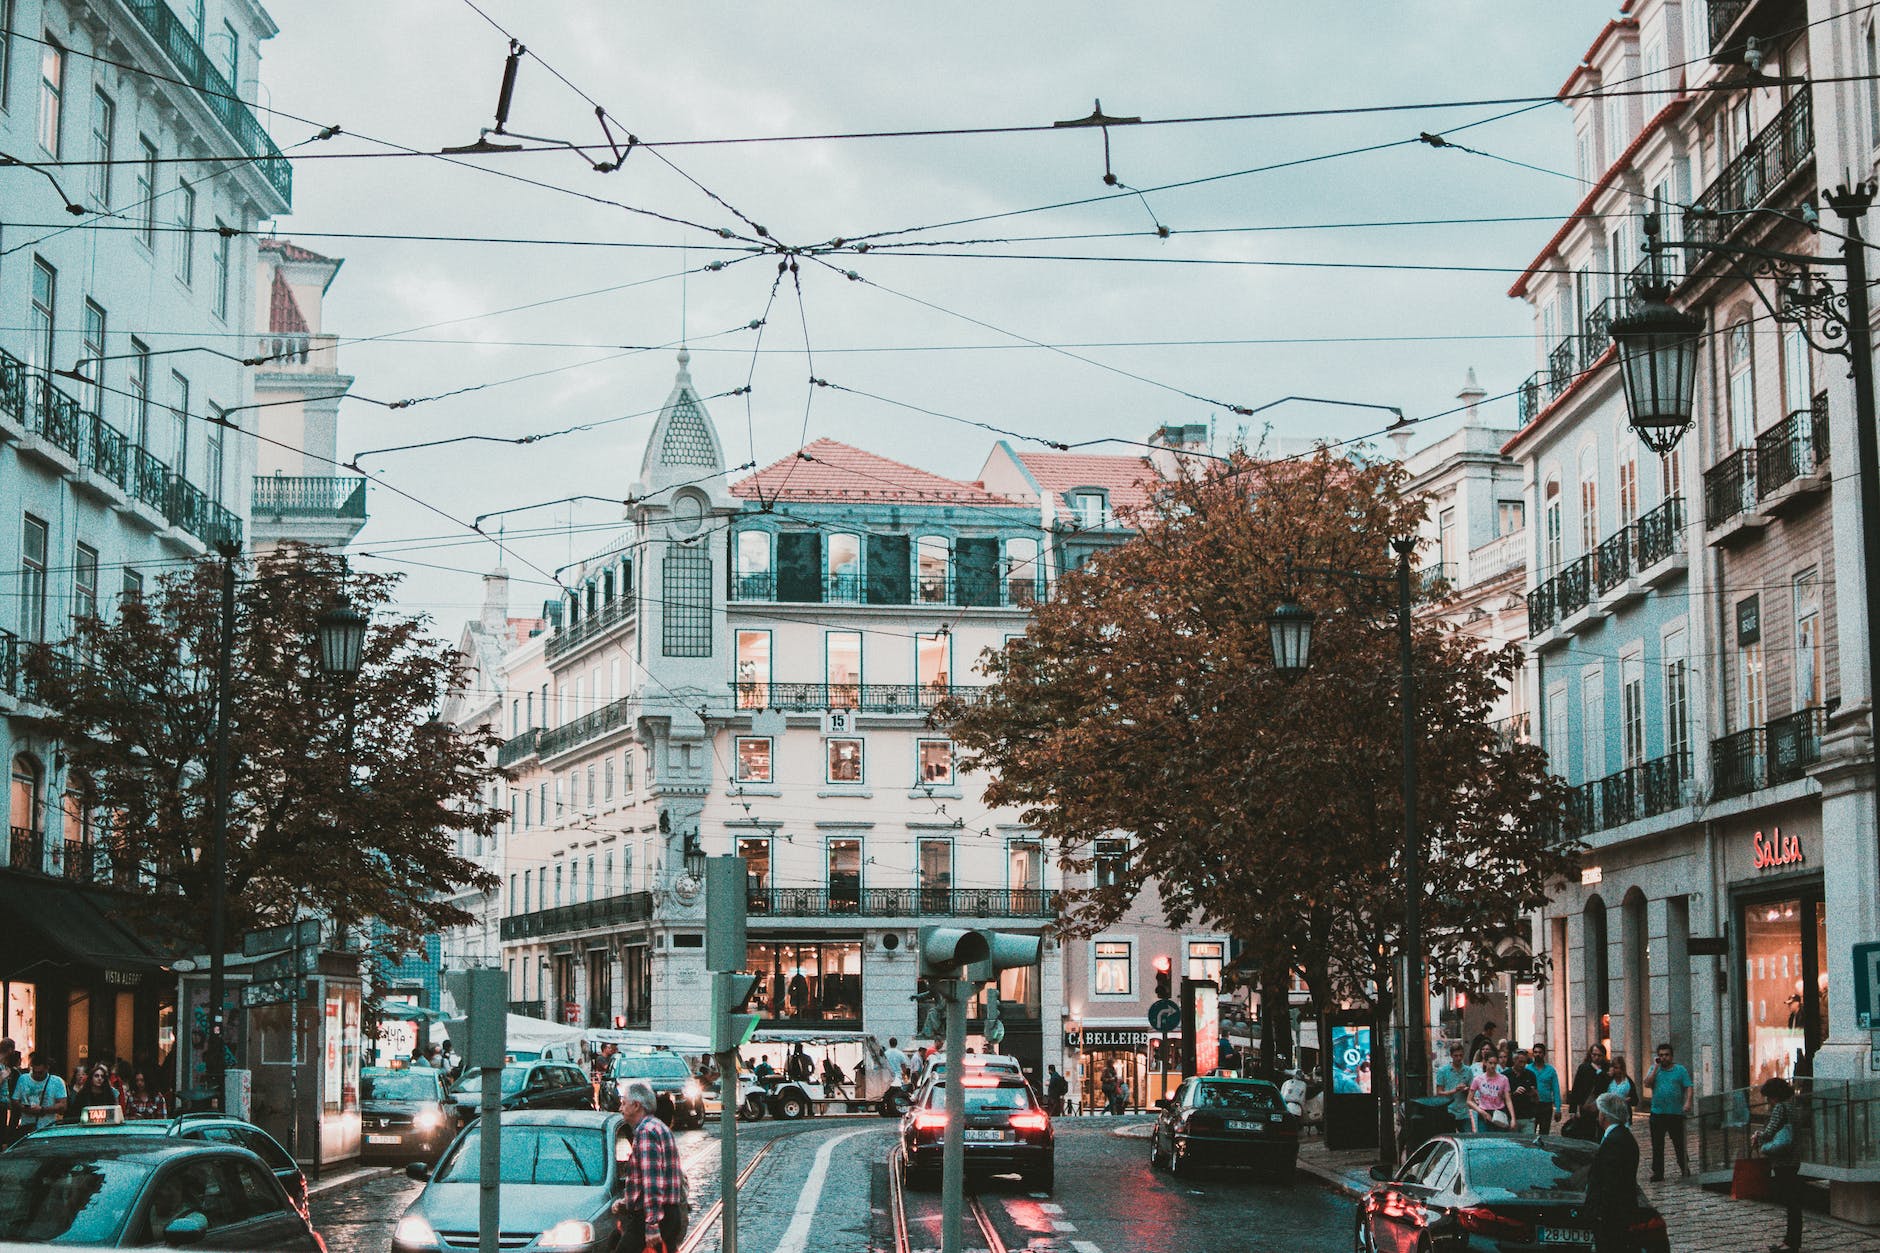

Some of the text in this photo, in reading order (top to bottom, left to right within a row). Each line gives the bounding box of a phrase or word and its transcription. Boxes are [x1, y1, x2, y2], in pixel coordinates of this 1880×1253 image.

[831, 715, 845, 727] 15
[1754, 827, 1803, 869] Salsa
[105, 969, 121, 984] VISTA
[89, 1110, 107, 1119] TAXI
